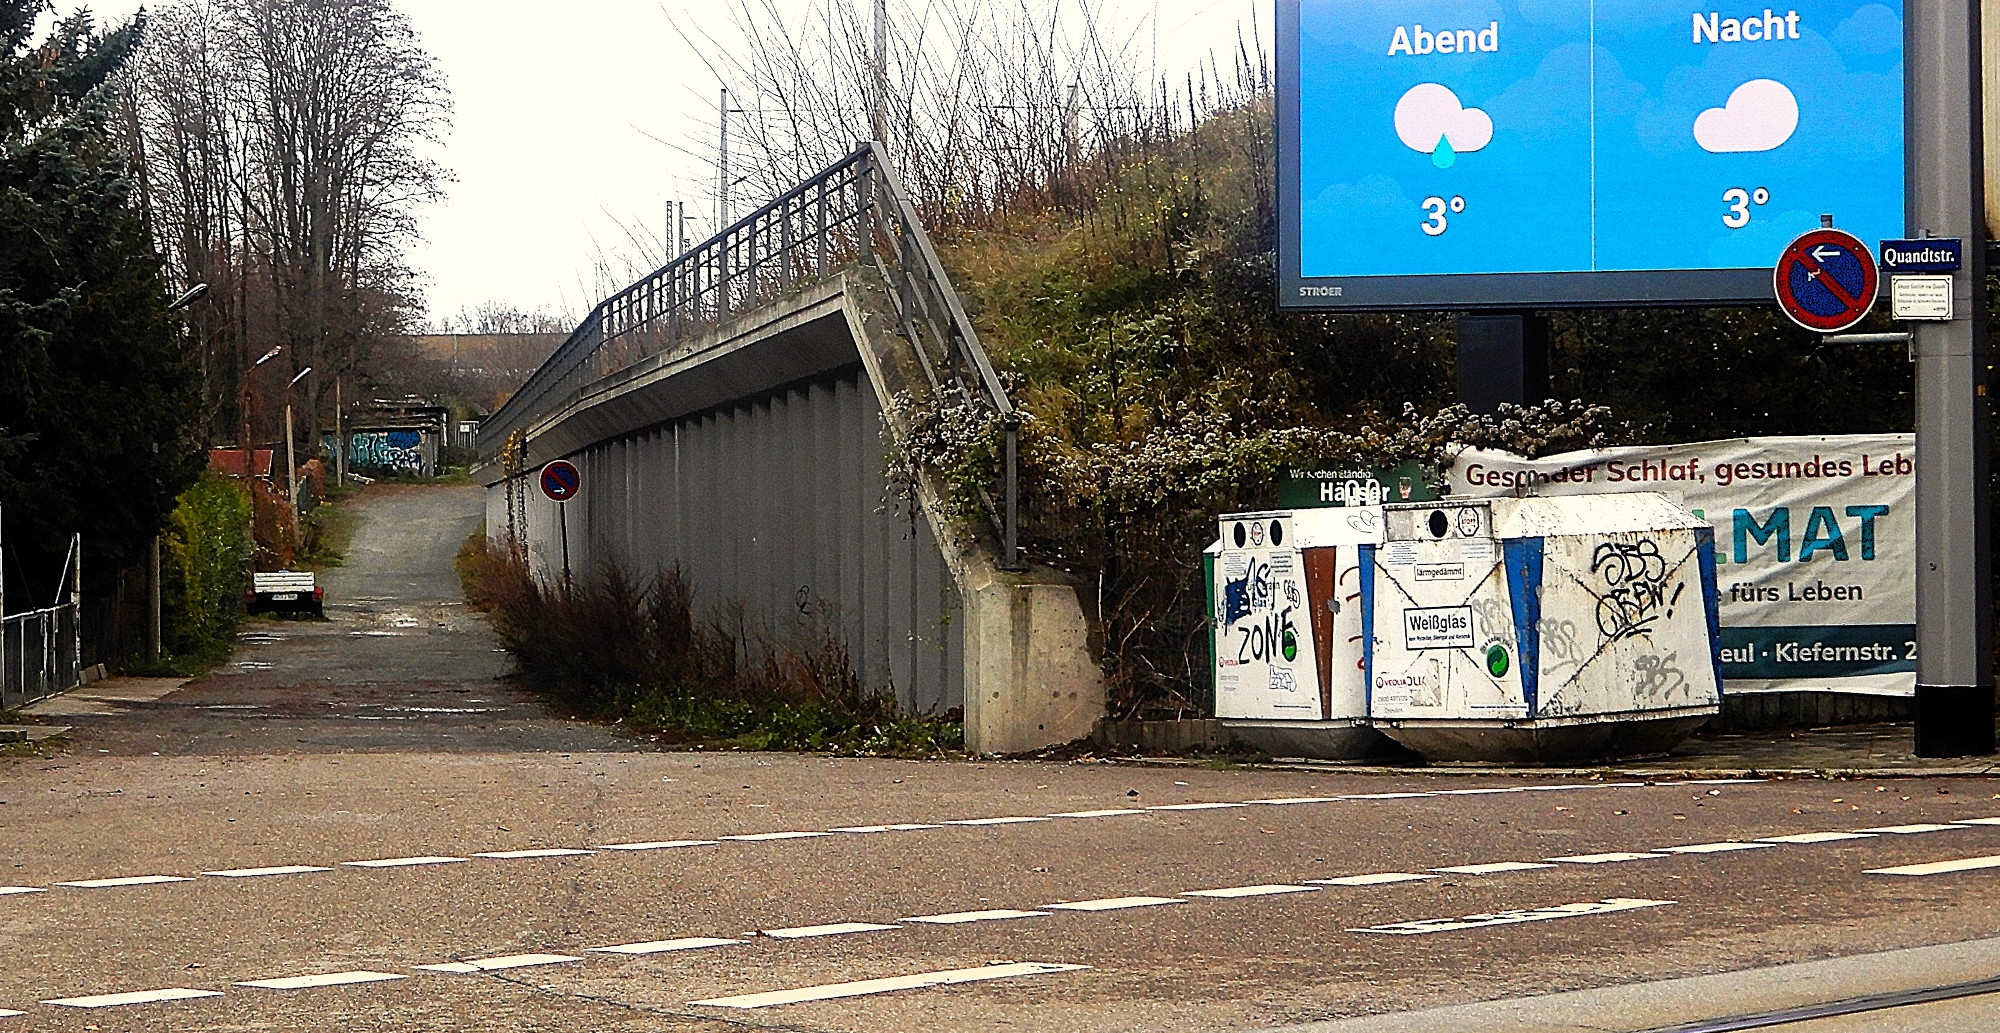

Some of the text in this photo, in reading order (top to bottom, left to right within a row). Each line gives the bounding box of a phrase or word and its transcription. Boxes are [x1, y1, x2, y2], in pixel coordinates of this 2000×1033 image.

[1387, 21, 1499, 56] Abend
[1692, 8, 1801, 44] Nacht
[1421, 194, 1466, 236] 3°
[1722, 186, 1770, 230] 3°
[1884, 247, 1955, 267] Quandtstr.
[1606, 457, 1705, 484] Schlaf,
[1714, 454, 1853, 487] gesundes
[1862, 452, 1915, 477] Leb
[1691, 504, 1890, 564] MAT
[1416, 568, 1462, 578] lärmgedämmt
[1730, 581, 1780, 602] fürs
[1788, 580, 1863, 601] Leben
[1409, 614, 1467, 632] Weißglas
[1718, 642, 1754, 663] eul
[1775, 641, 1898, 662] Kiefernstr.
